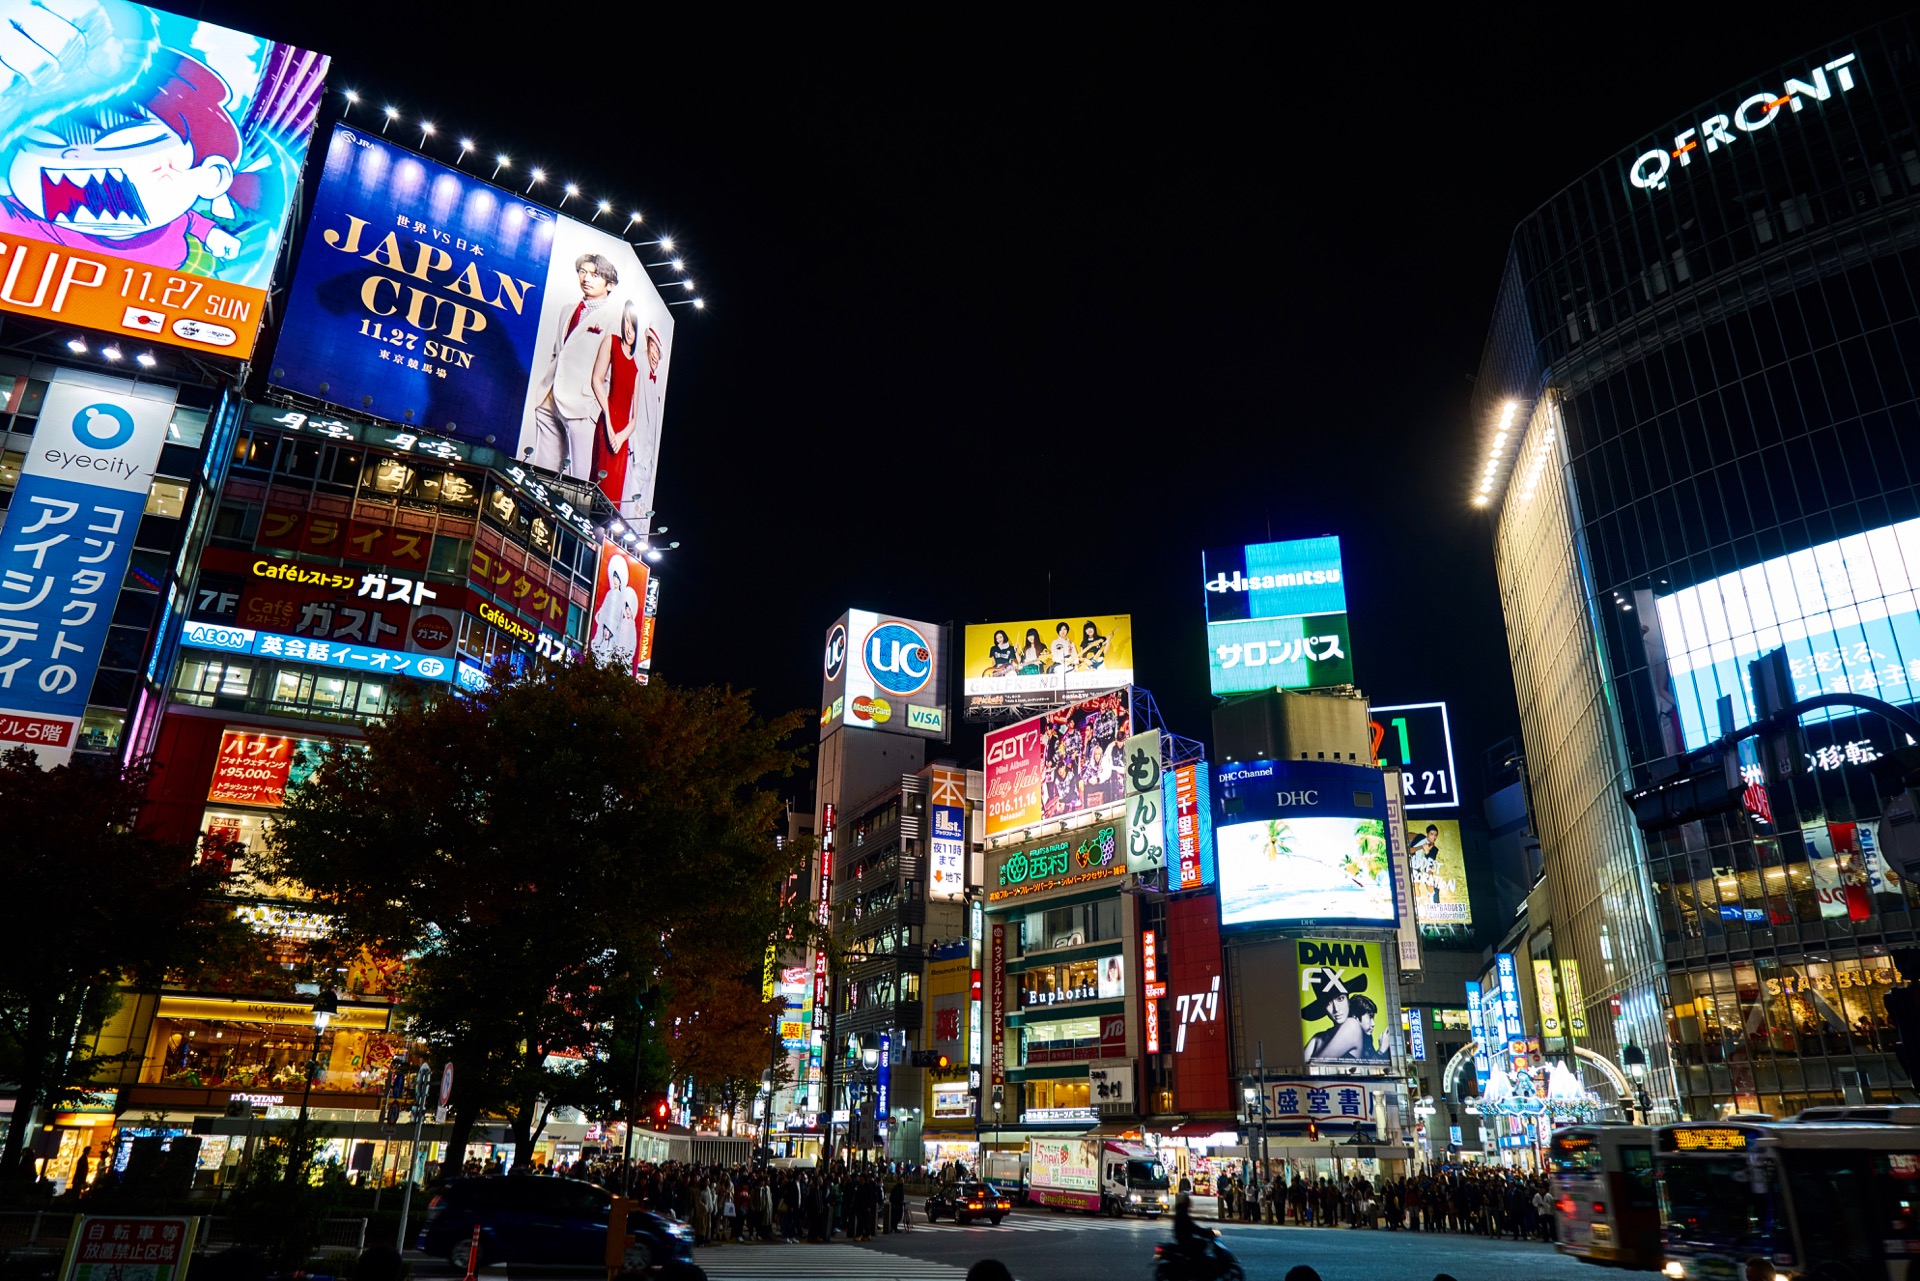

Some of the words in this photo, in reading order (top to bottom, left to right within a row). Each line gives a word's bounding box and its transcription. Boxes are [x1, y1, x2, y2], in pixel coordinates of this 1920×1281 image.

[1630, 53, 1855, 190] QFRONT
[355, 139, 376, 151] JRA
[396, 213, 428, 236] 世界
[432, 229, 451, 246] VS
[454, 237, 485, 258] 日本
[323, 213, 537, 317] JAPAN
[0, 242, 107, 312] UP
[120, 267, 204, 309] 11.27
[204, 294, 251, 323] SUN
[360, 275, 488, 347] CUP
[357, 319, 417, 351] 11.27
[422, 338, 476, 371] SUN
[44, 448, 140, 481] eyecity
[264, 512, 423, 561] プライス
[357, 572, 438, 607] ガスト
[471, 549, 563, 622] コンタクト
[38, 505, 125, 695] コンタクトの
[198, 589, 240, 614] 7F
[295, 600, 398, 644] ガスト
[191, 627, 246, 650] AEON
[417, 629, 448, 642] ガスト
[260, 635, 411, 672] 英会話イーオン
[420, 660, 441, 675] 6F
[1216, 635, 1345, 669] サロンパス
[853, 702, 891, 716] MasterCard
[912, 711, 941, 726] VISA
[224, 740, 284, 759] ハワイ
[1219, 772, 1237, 783] DHC
[1238, 767, 1273, 780] Channel
[1425, 770, 1448, 795] 21
[989, 792, 1037, 817] 2016.11.16
[1277, 790, 1319, 807] DHC
[213, 818, 241, 827] SALE
[1176, 770, 1198, 882] 三千里薬品
[938, 855, 956, 867] まで
[1029, 850, 1069, 879] 西村
[945, 872, 961, 884] 地下
[1301, 917, 1316, 926] DHC
[1299, 941, 1369, 968] DMM
[1301, 967, 1348, 993] FX
[1029, 986, 1095, 1006] Euphoria
[1499, 958, 1521, 1034] 洋服の青山
[248, 1004, 305, 1014] L'OCCITANE
[266, 1013, 284, 1021] Café
[783, 1022, 801, 1038] 薬
[1103, 1019, 1124, 1040] JTB
[230, 1092, 284, 1104] L'OCCITANE
[88, 1224, 180, 1241] 自転車等
[83, 1242, 176, 1261] 放置禁止区域
